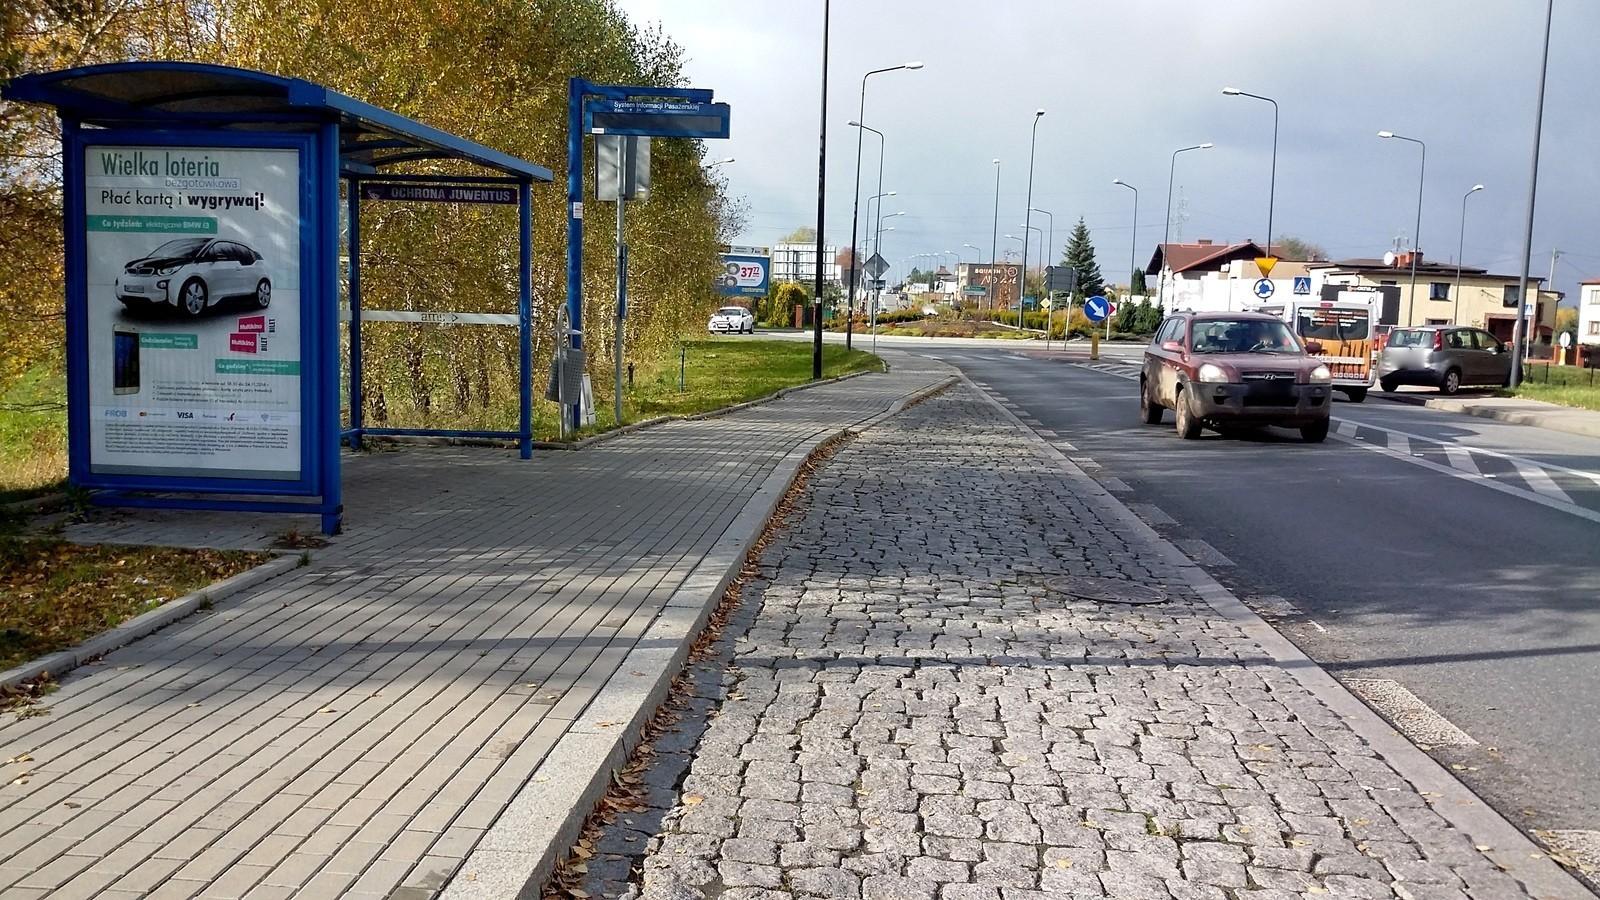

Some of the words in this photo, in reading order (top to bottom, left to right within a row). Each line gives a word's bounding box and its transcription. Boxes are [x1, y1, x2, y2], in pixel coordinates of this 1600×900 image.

[614, 101, 635, 109] System
[636, 102, 663, 110] Informacji
[664, 102, 700, 111] Pasażerskiej
[102, 152, 159, 176] Wielka
[166, 152, 220, 177] loteria
[101, 189, 132, 205] Płać
[136, 190, 173, 208] kartą
[178, 192, 182, 205] i
[187, 192, 265, 210] wygrywaj!
[391, 187, 446, 200] OCHRONA
[449, 189, 511, 202] JUWENTUS
[177, 411, 194, 419] VISA
